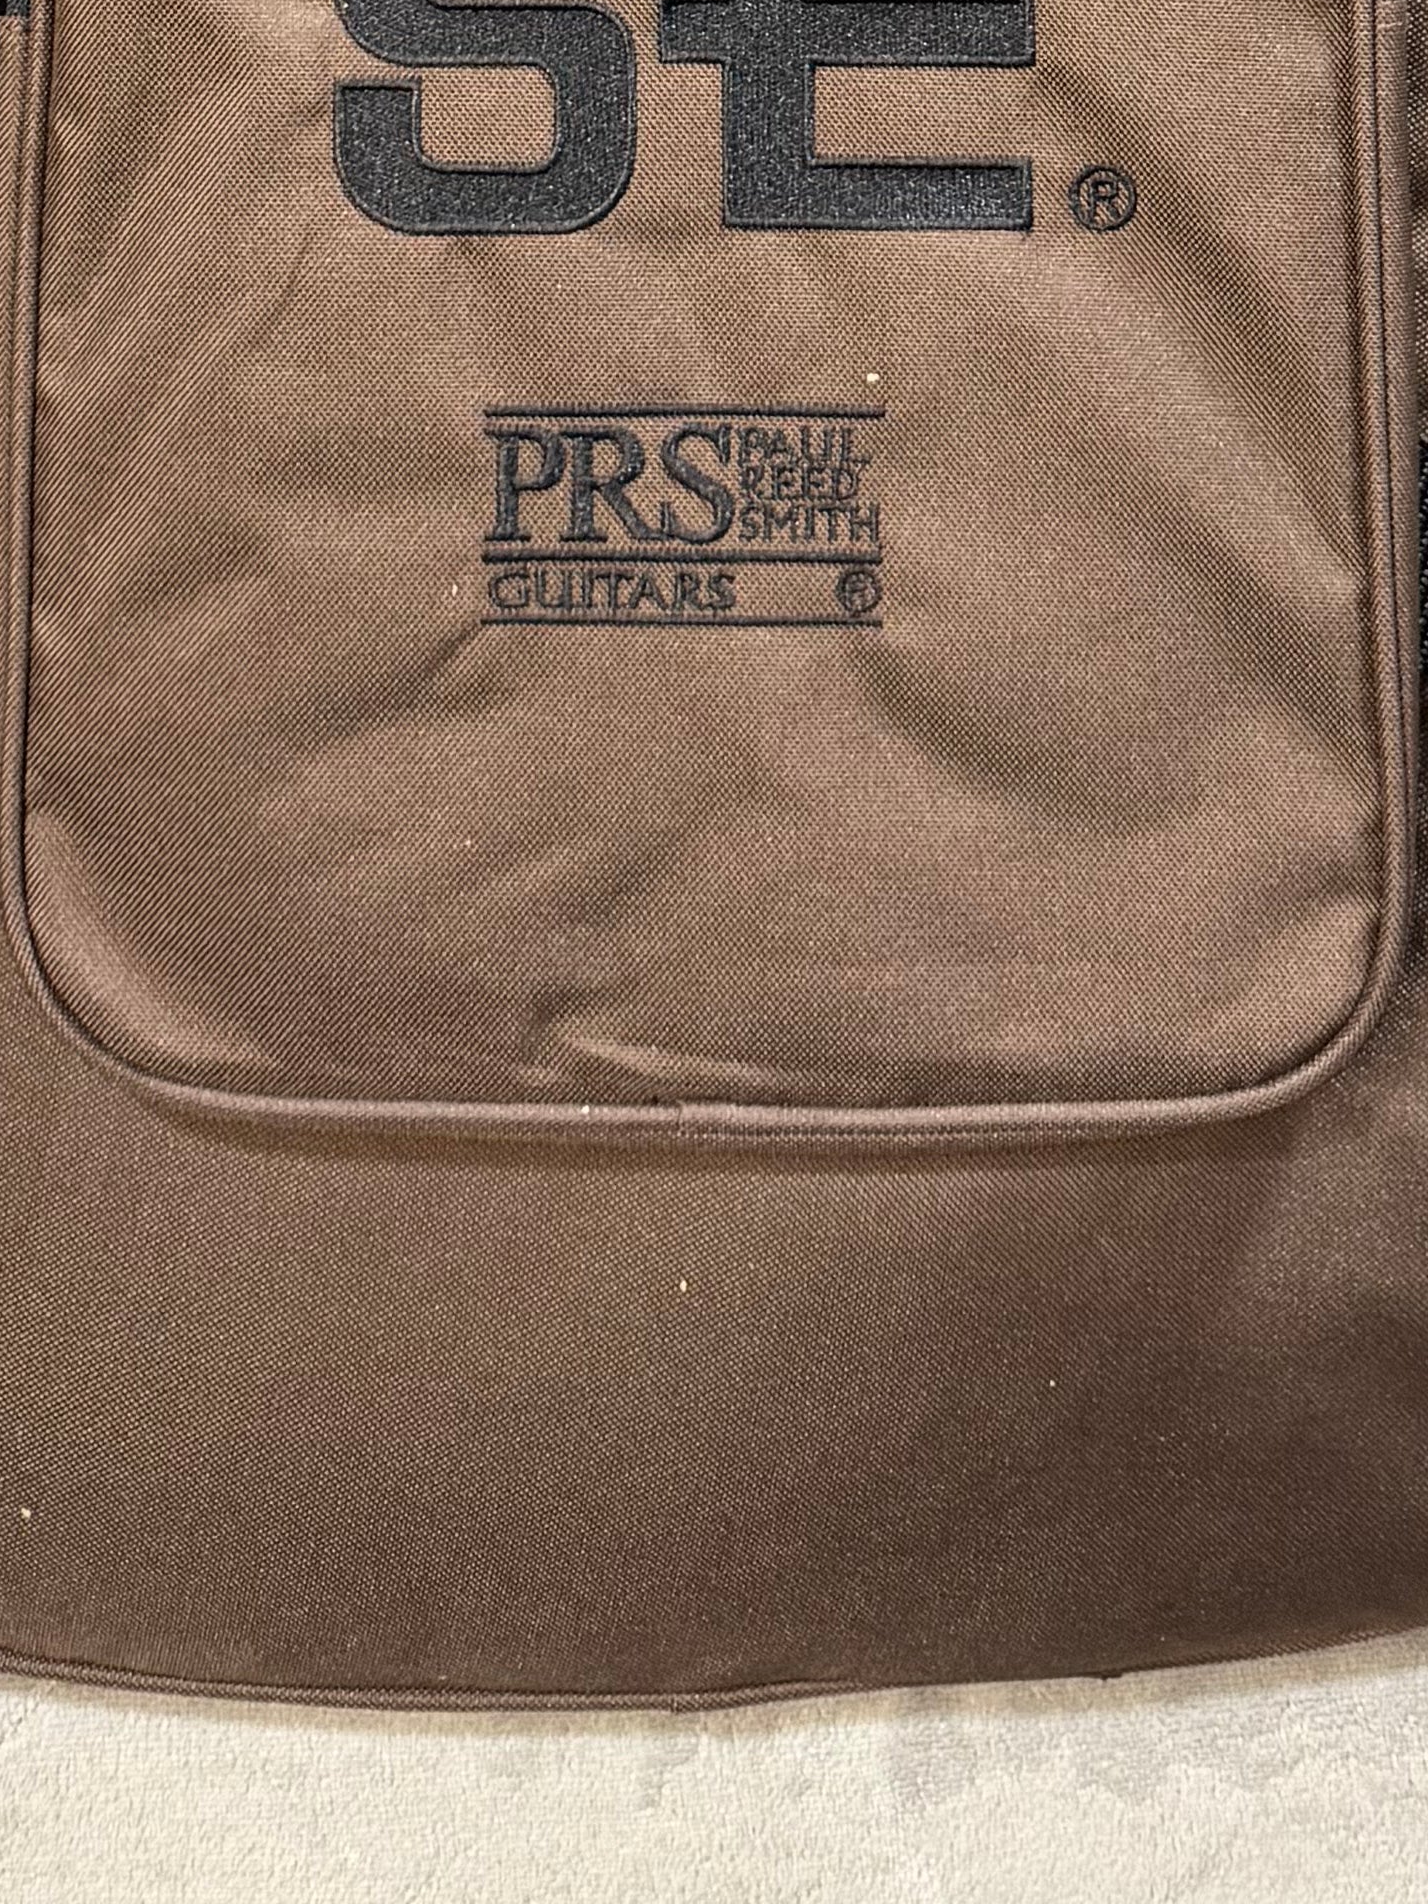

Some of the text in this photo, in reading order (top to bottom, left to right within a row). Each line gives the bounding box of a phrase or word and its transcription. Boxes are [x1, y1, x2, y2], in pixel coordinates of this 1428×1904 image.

[737, 426, 870, 468] PAUL
[483, 422, 736, 545] PRS
[738, 464, 864, 501] REED
[738, 502, 881, 543] SMITH
[488, 569, 737, 611] GUITARS
